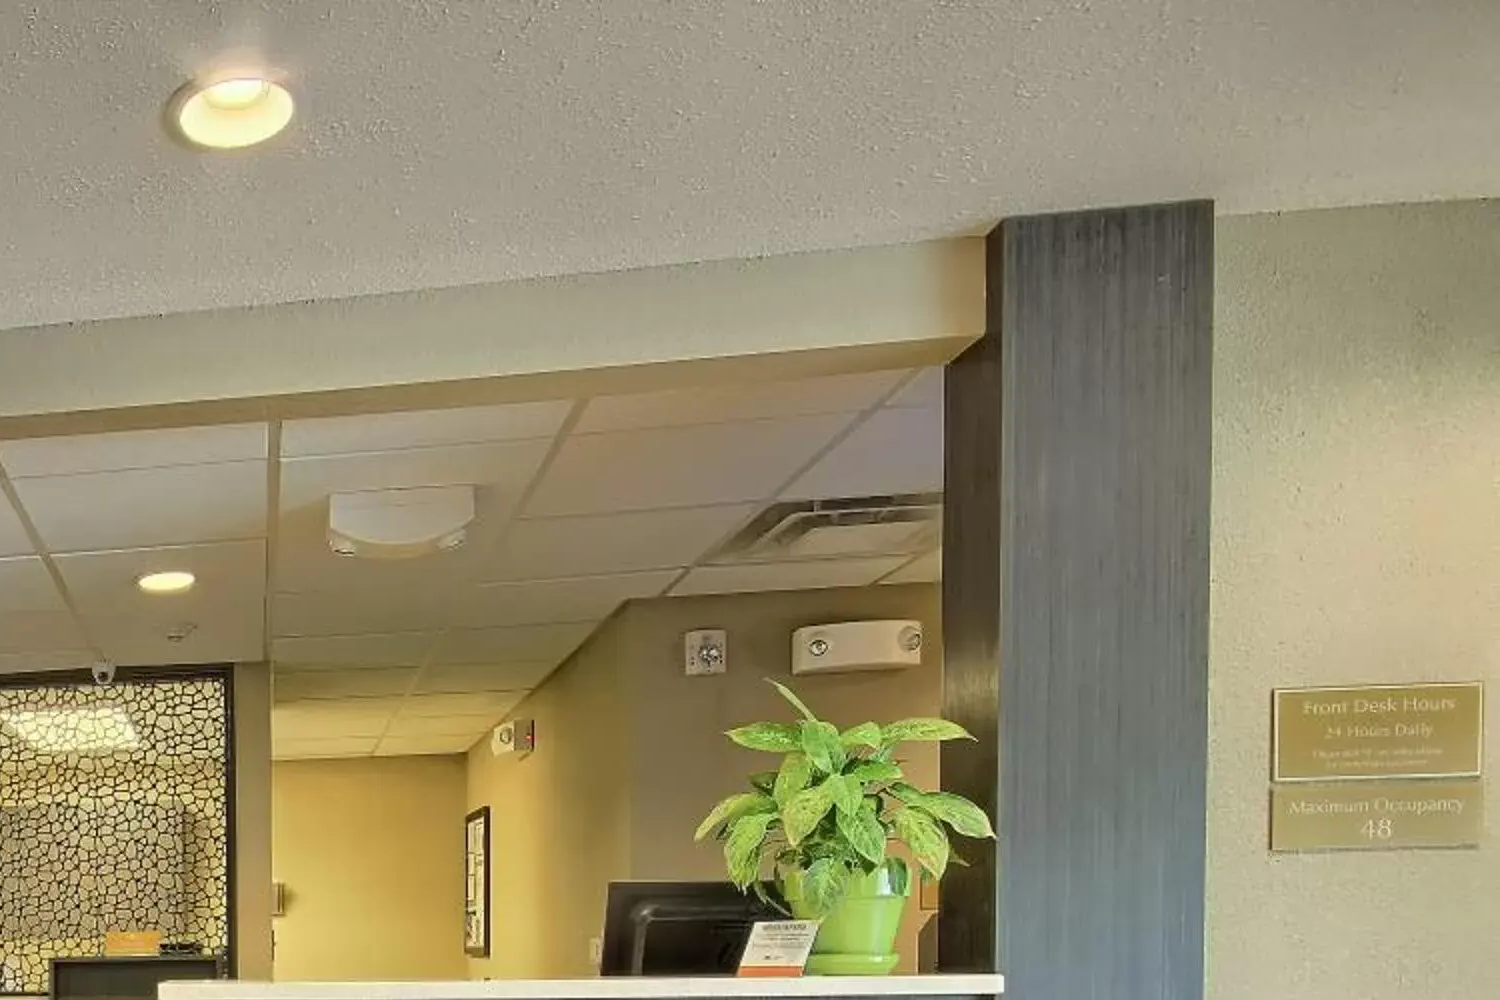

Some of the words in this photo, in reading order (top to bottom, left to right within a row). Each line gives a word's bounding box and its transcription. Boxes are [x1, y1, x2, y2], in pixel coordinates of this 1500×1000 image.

[1303, 700, 1347, 716] Front
[1353, 696, 1397, 713] Desk
[1402, 695, 1457, 713] Hours
[1346, 723, 1390, 738] Hours
[1395, 722, 1434, 738] Daily
[1285, 799, 1369, 816] Maximum
[1373, 796, 1464, 816] Occupancy
[1360, 818, 1393, 840] 48
